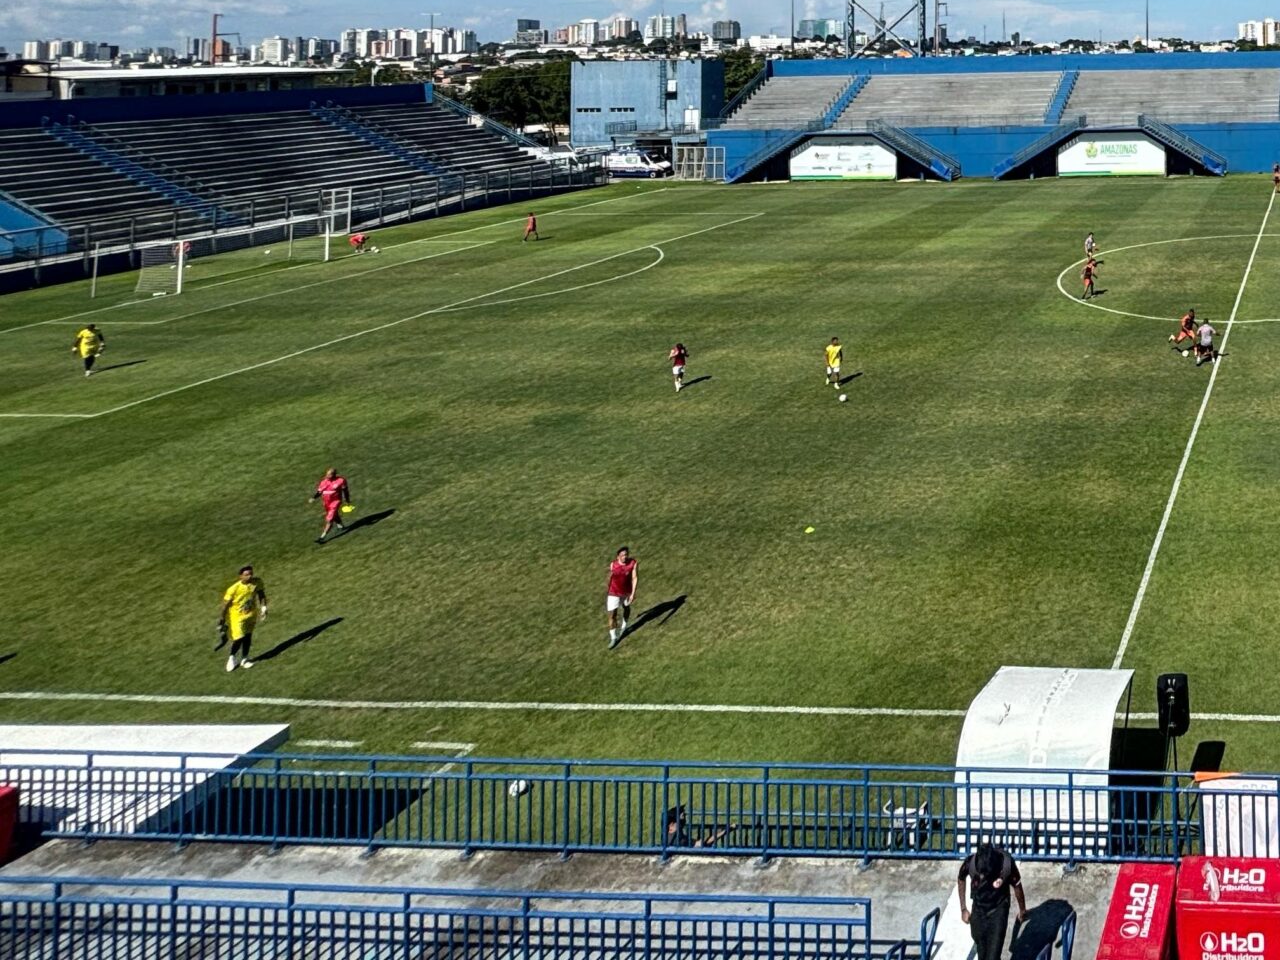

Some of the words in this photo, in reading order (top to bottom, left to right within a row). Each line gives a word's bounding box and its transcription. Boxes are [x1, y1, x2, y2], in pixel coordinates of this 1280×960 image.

[1101, 144, 1138, 155] AMAZONAS
[1223, 868, 1266, 884] H2O
[1123, 883, 1149, 920] H2O
[1221, 932, 1264, 952] H2O
